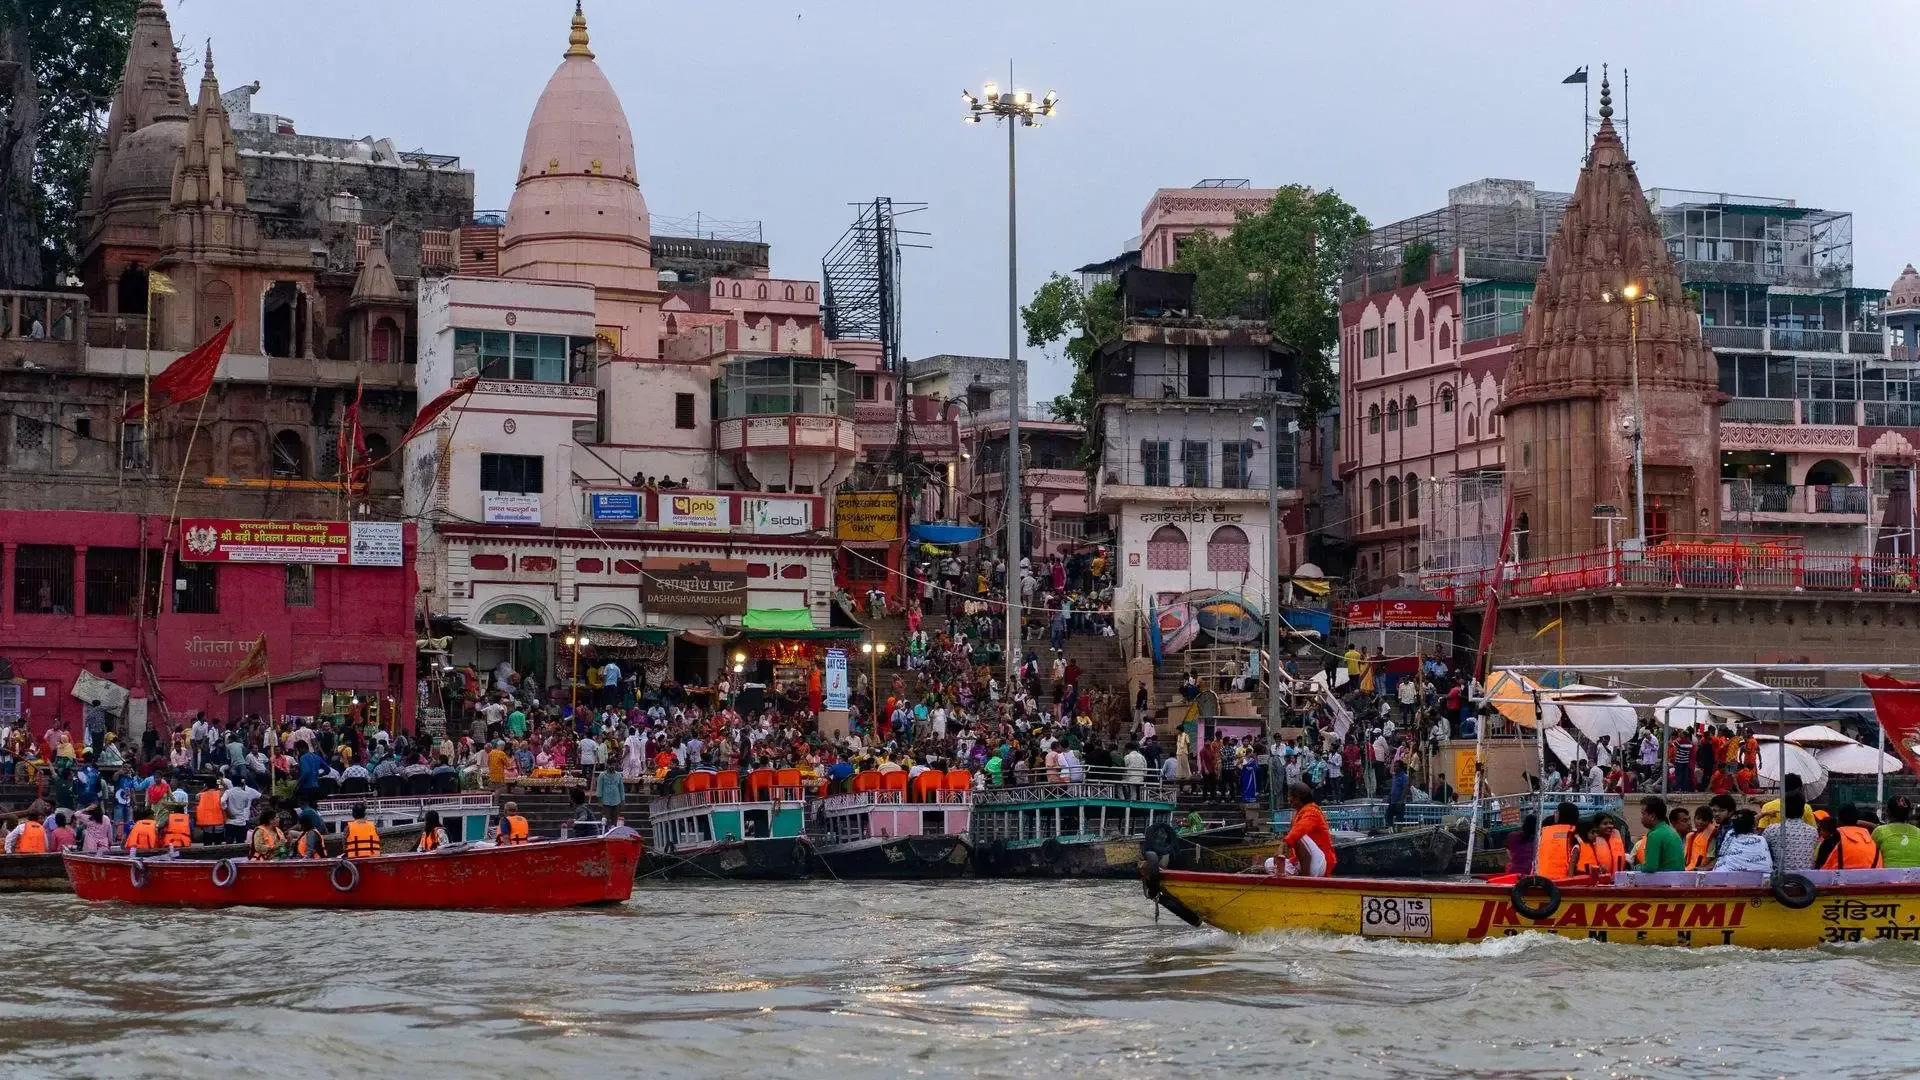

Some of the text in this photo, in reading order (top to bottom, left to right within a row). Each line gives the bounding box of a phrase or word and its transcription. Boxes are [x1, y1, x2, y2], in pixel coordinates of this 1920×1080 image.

[692, 501, 714, 513] pnb
[771, 515, 802, 526] sidbi
[1213, 513, 1243, 522] घाट
[220, 528, 233, 541] श्री
[254, 530, 284, 542] शीतला
[286, 533, 307, 543] माता
[309, 532, 327, 545] माई
[712, 580, 735, 591] घाट
[647, 594, 742, 604] DASHASHVAMEDH GHAT
[184, 636, 234, 653] शीतला
[1408, 901, 1423, 910] TS
[1366, 898, 1400, 925] 88
[1407, 913, 1430, 934] (LKO)
